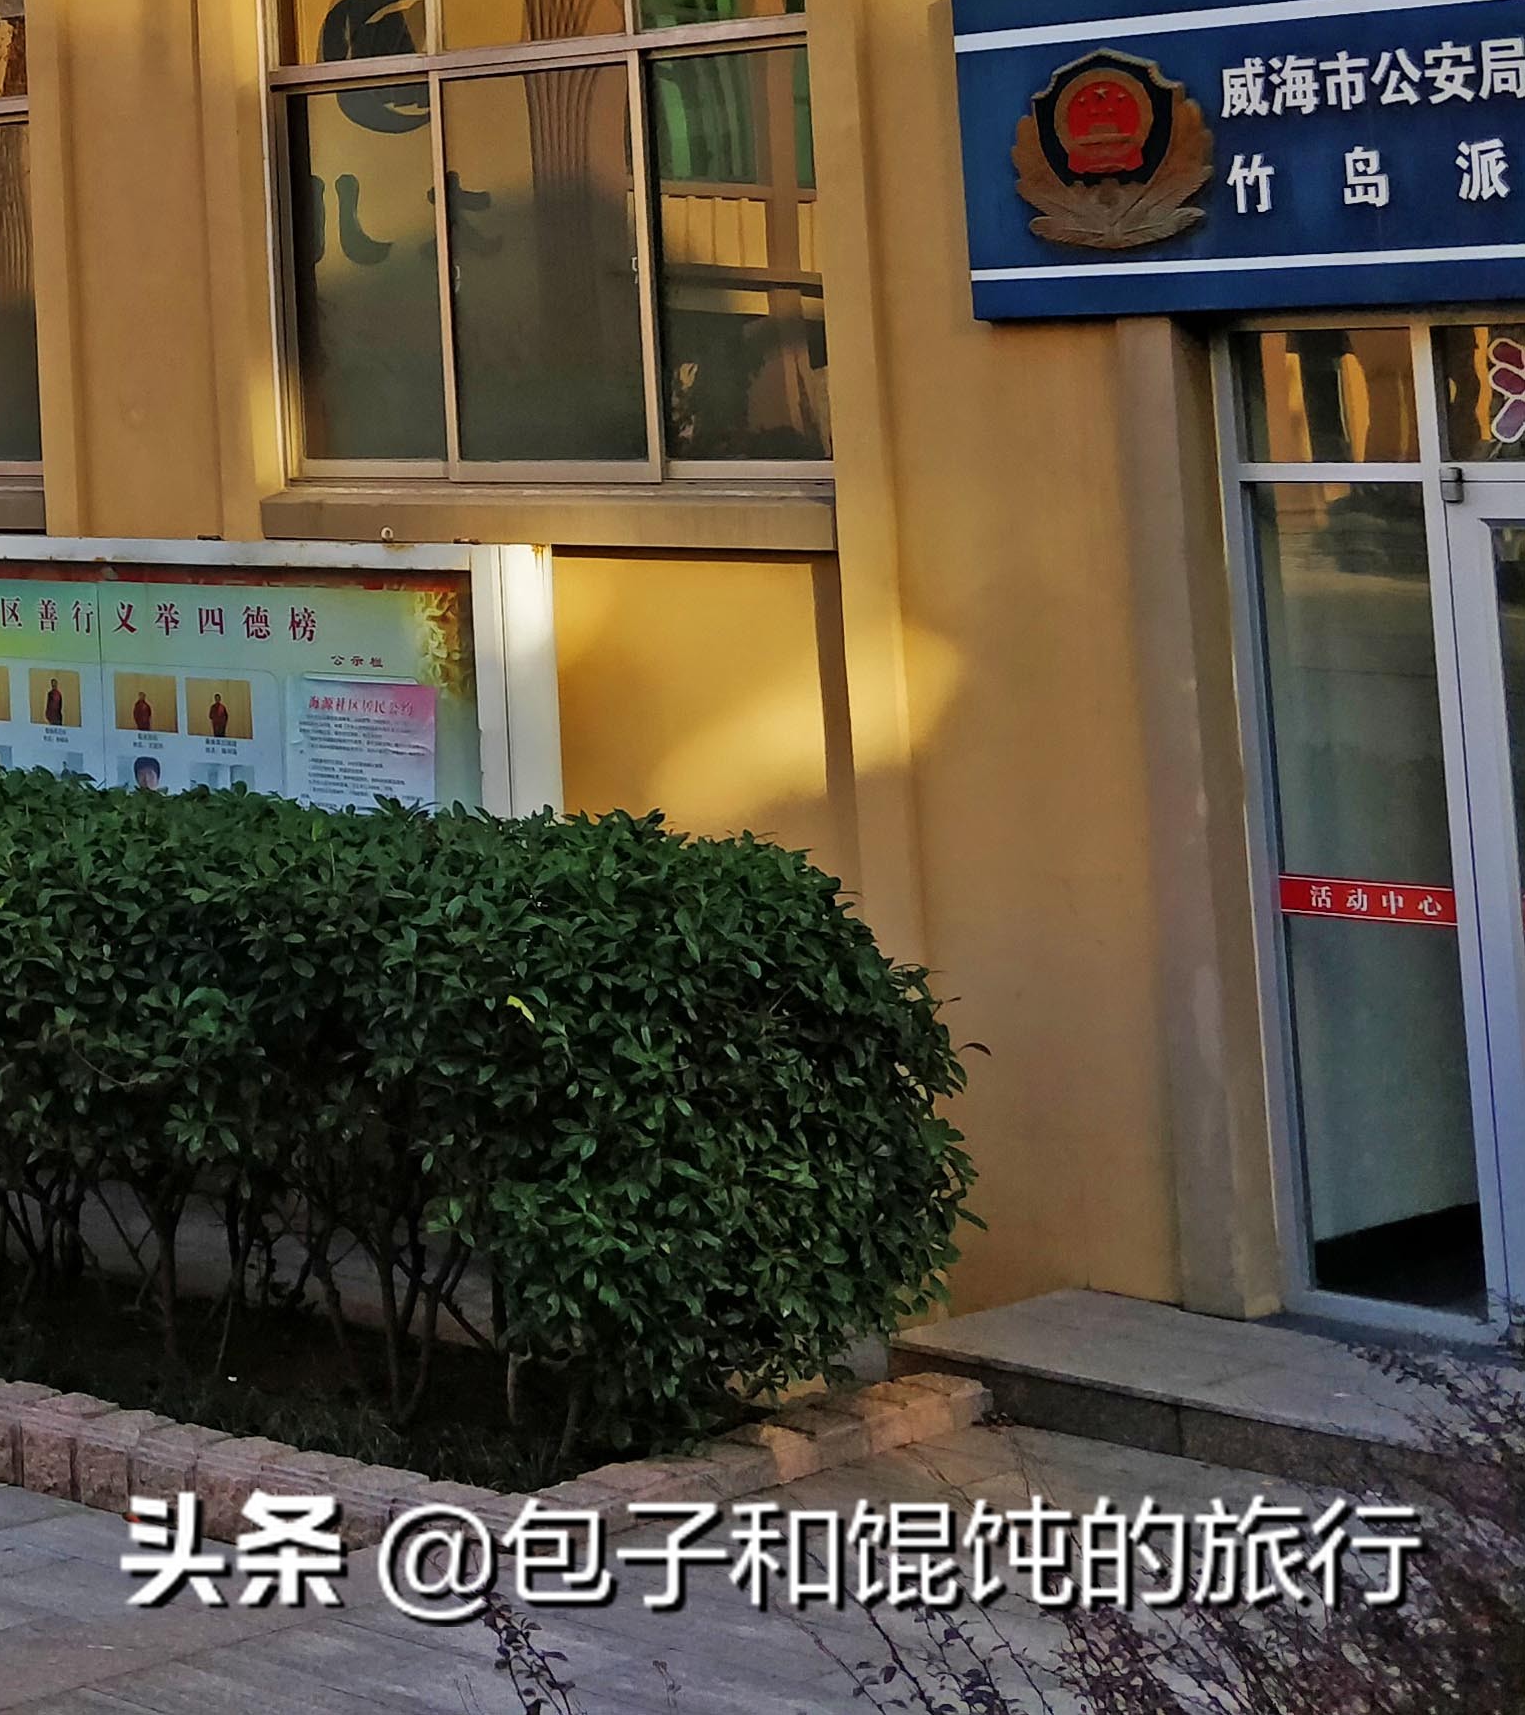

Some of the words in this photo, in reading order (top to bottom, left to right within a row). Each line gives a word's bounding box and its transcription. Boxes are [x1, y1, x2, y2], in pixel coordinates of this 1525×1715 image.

[1220, 36, 1525, 119] 威海市公安局
[1226, 137, 1511, 214] 竹岛派
[330, 654, 385, 668] 公示栏
[1309, 884, 1443, 917] 活动中心
